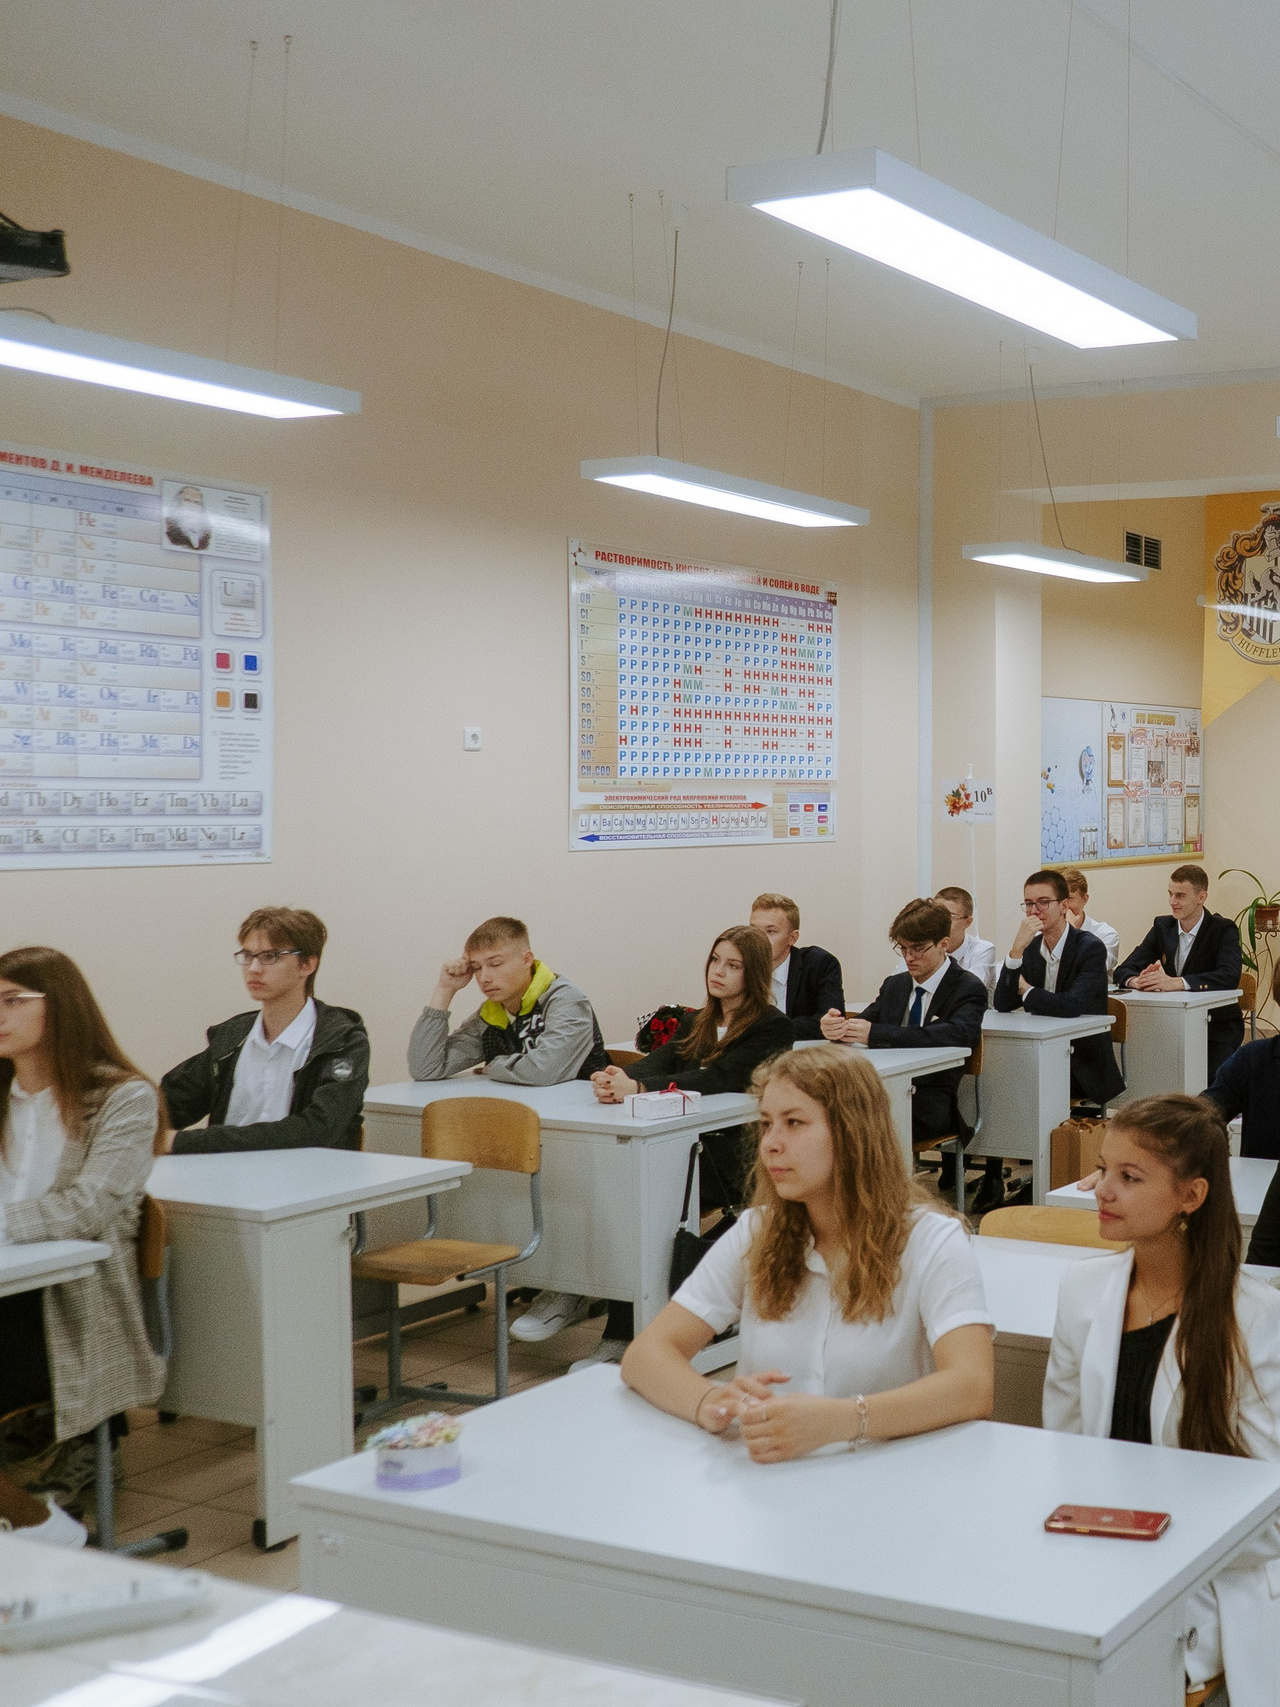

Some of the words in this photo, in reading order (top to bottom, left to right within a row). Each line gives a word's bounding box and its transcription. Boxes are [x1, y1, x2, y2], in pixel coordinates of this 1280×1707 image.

[79, 464, 154, 487] МЕНДЕЛЕЕВА
[595, 550, 673, 571] РАСТВОРИМОСТЬ
[762, 577, 768, 585] И
[769, 578, 793, 590] СОЛЕЙ
[794, 582, 800, 591] В
[800, 583, 820, 595] ВОДЕ
